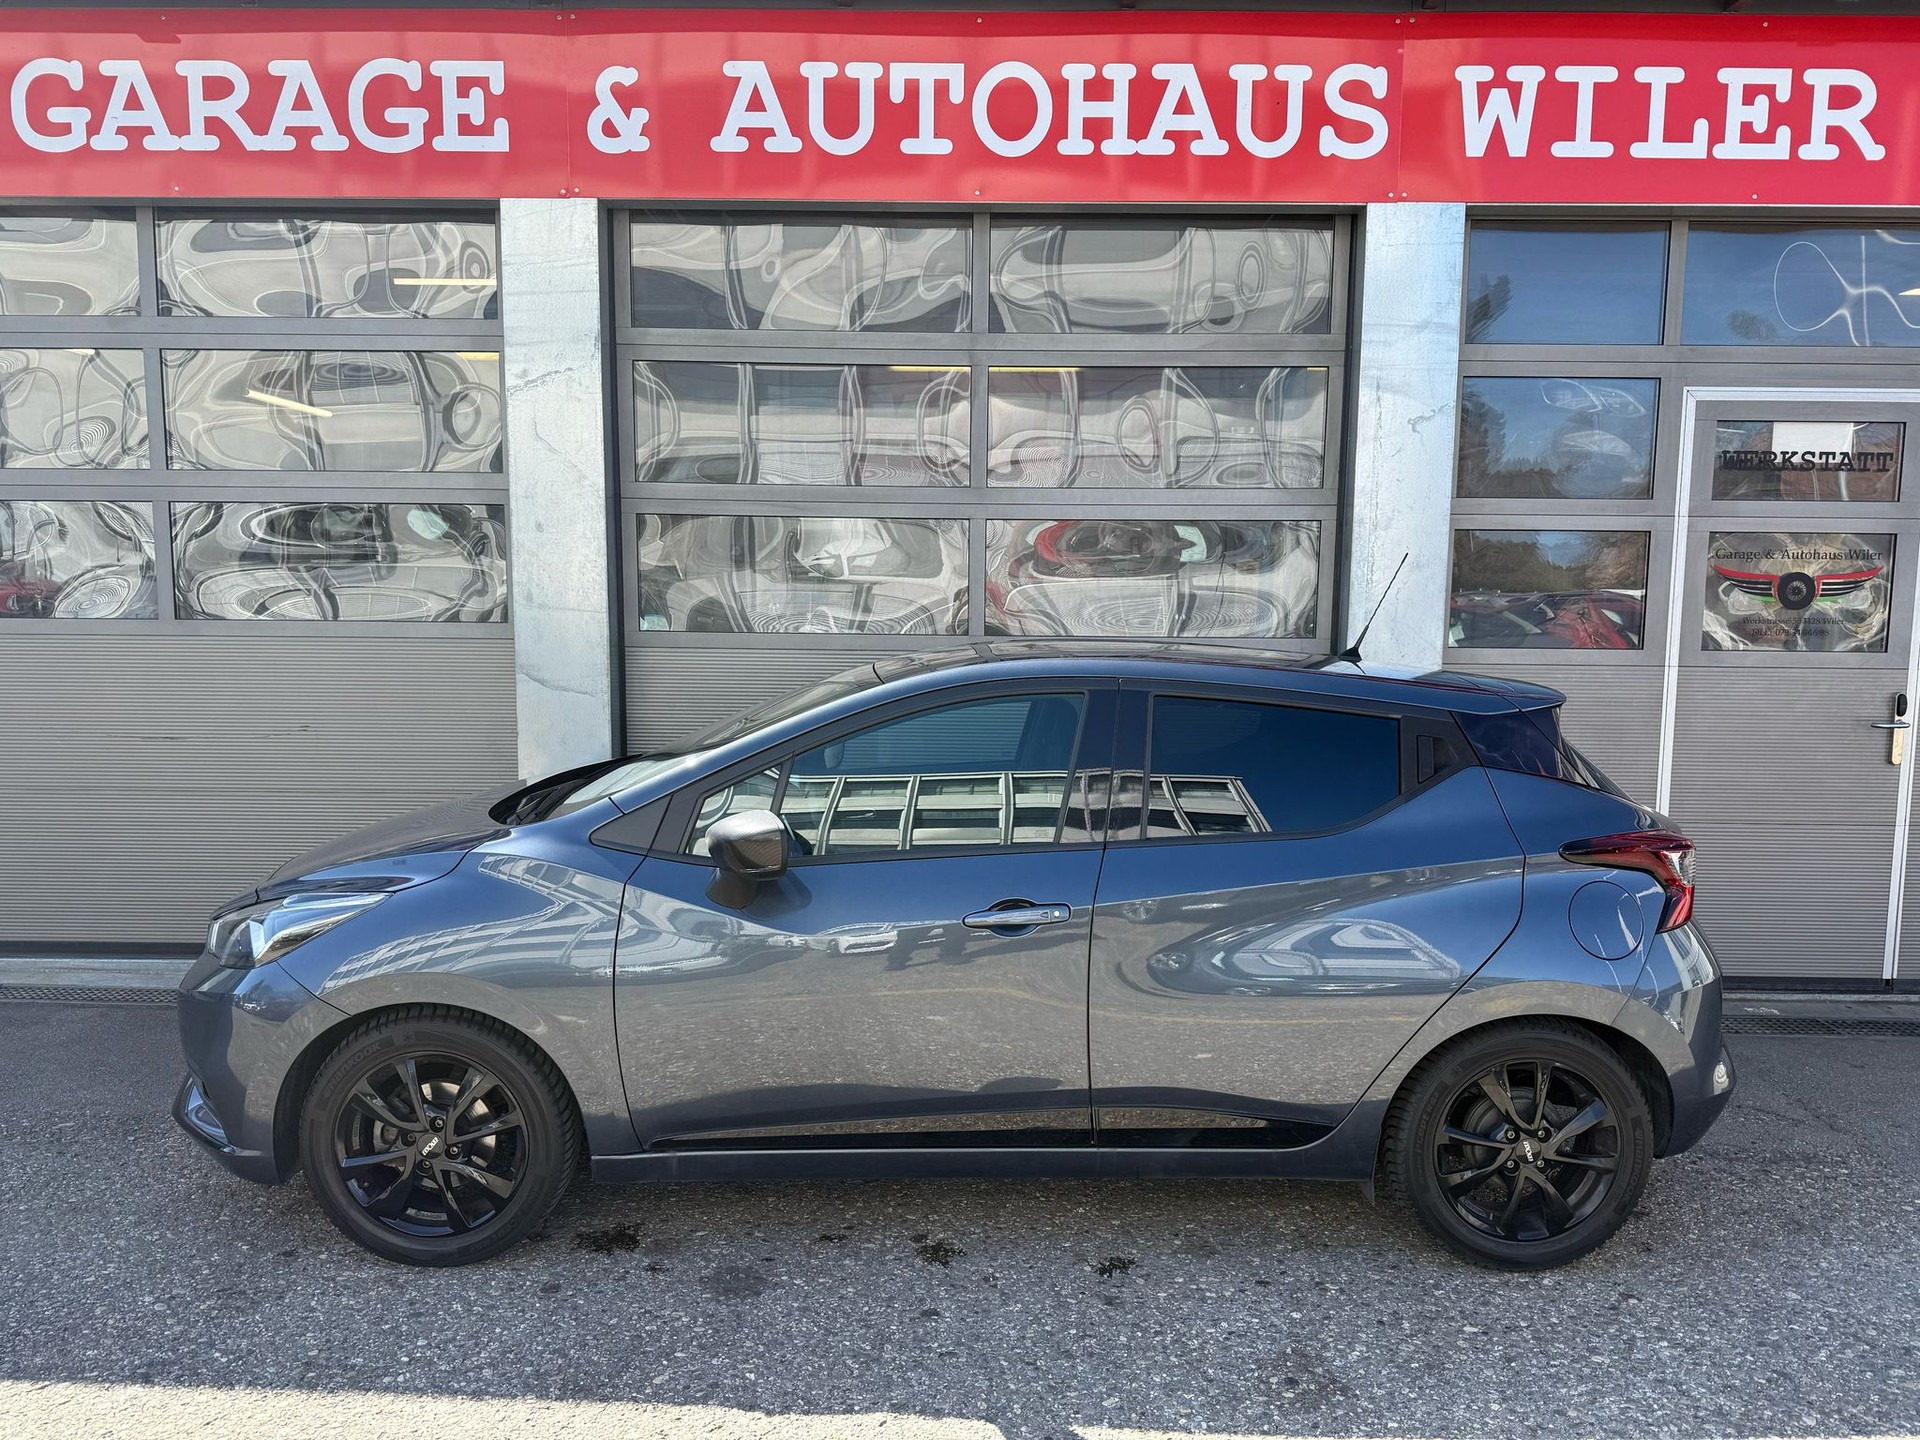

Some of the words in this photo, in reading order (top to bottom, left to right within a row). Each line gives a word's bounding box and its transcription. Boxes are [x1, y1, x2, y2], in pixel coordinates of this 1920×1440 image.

[11, 58, 509, 153] GARAGE
[587, 66, 650, 153] &
[710, 61, 1388, 159] AUTOHAUS
[1455, 66, 1885, 160] WILER
[1720, 451, 1893, 472] WERKSTATT
[1715, 548, 1761, 563] Garage
[1765, 548, 1777, 560] &
[1780, 548, 1843, 560] Autohaus
[1847, 549, 1883, 560] Wiler
[1823, 617, 1844, 625] Wiler
